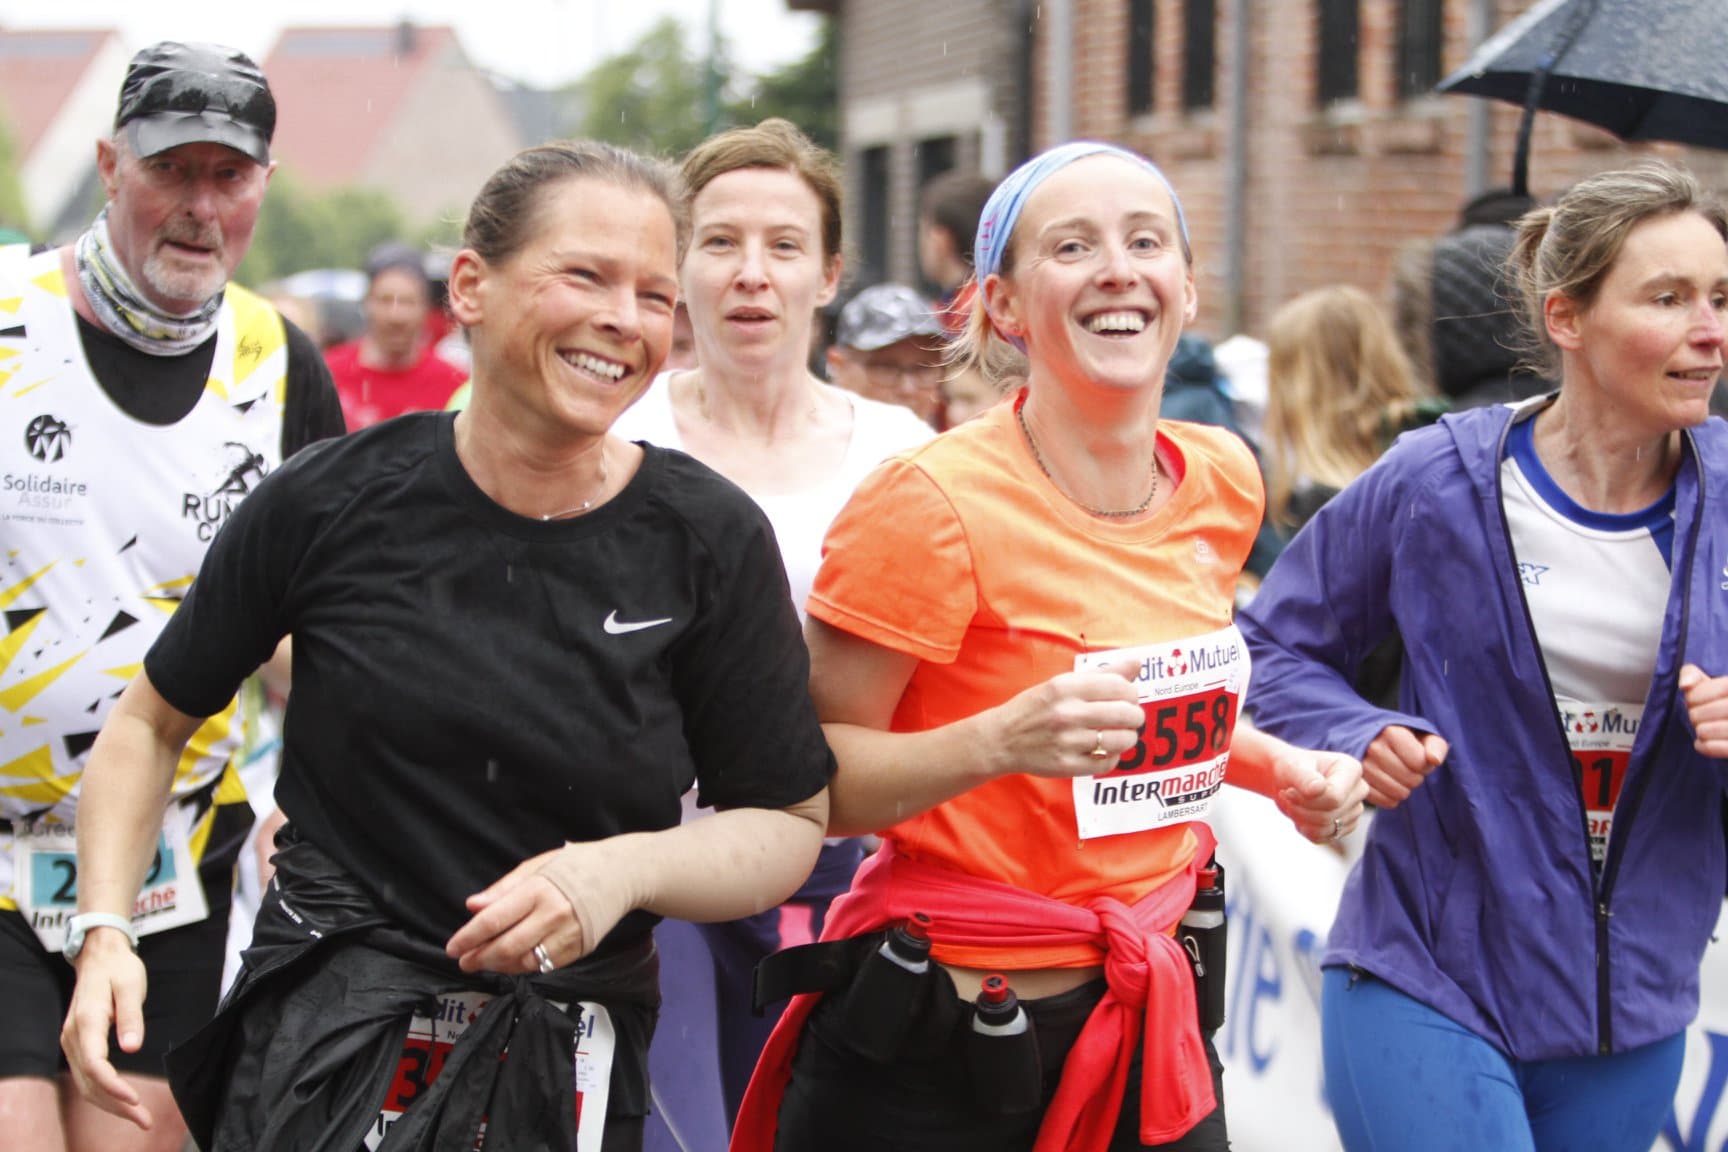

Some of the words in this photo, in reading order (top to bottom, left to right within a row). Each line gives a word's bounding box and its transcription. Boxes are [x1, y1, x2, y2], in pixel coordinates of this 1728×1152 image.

[3, 473, 88, 496] Solidaire
[17, 491, 73, 510] Assur
[197, 521, 221, 542] C
[1190, 642, 1241, 674] Mutuel
[1157, 802, 1209, 821] LAMBERSART
